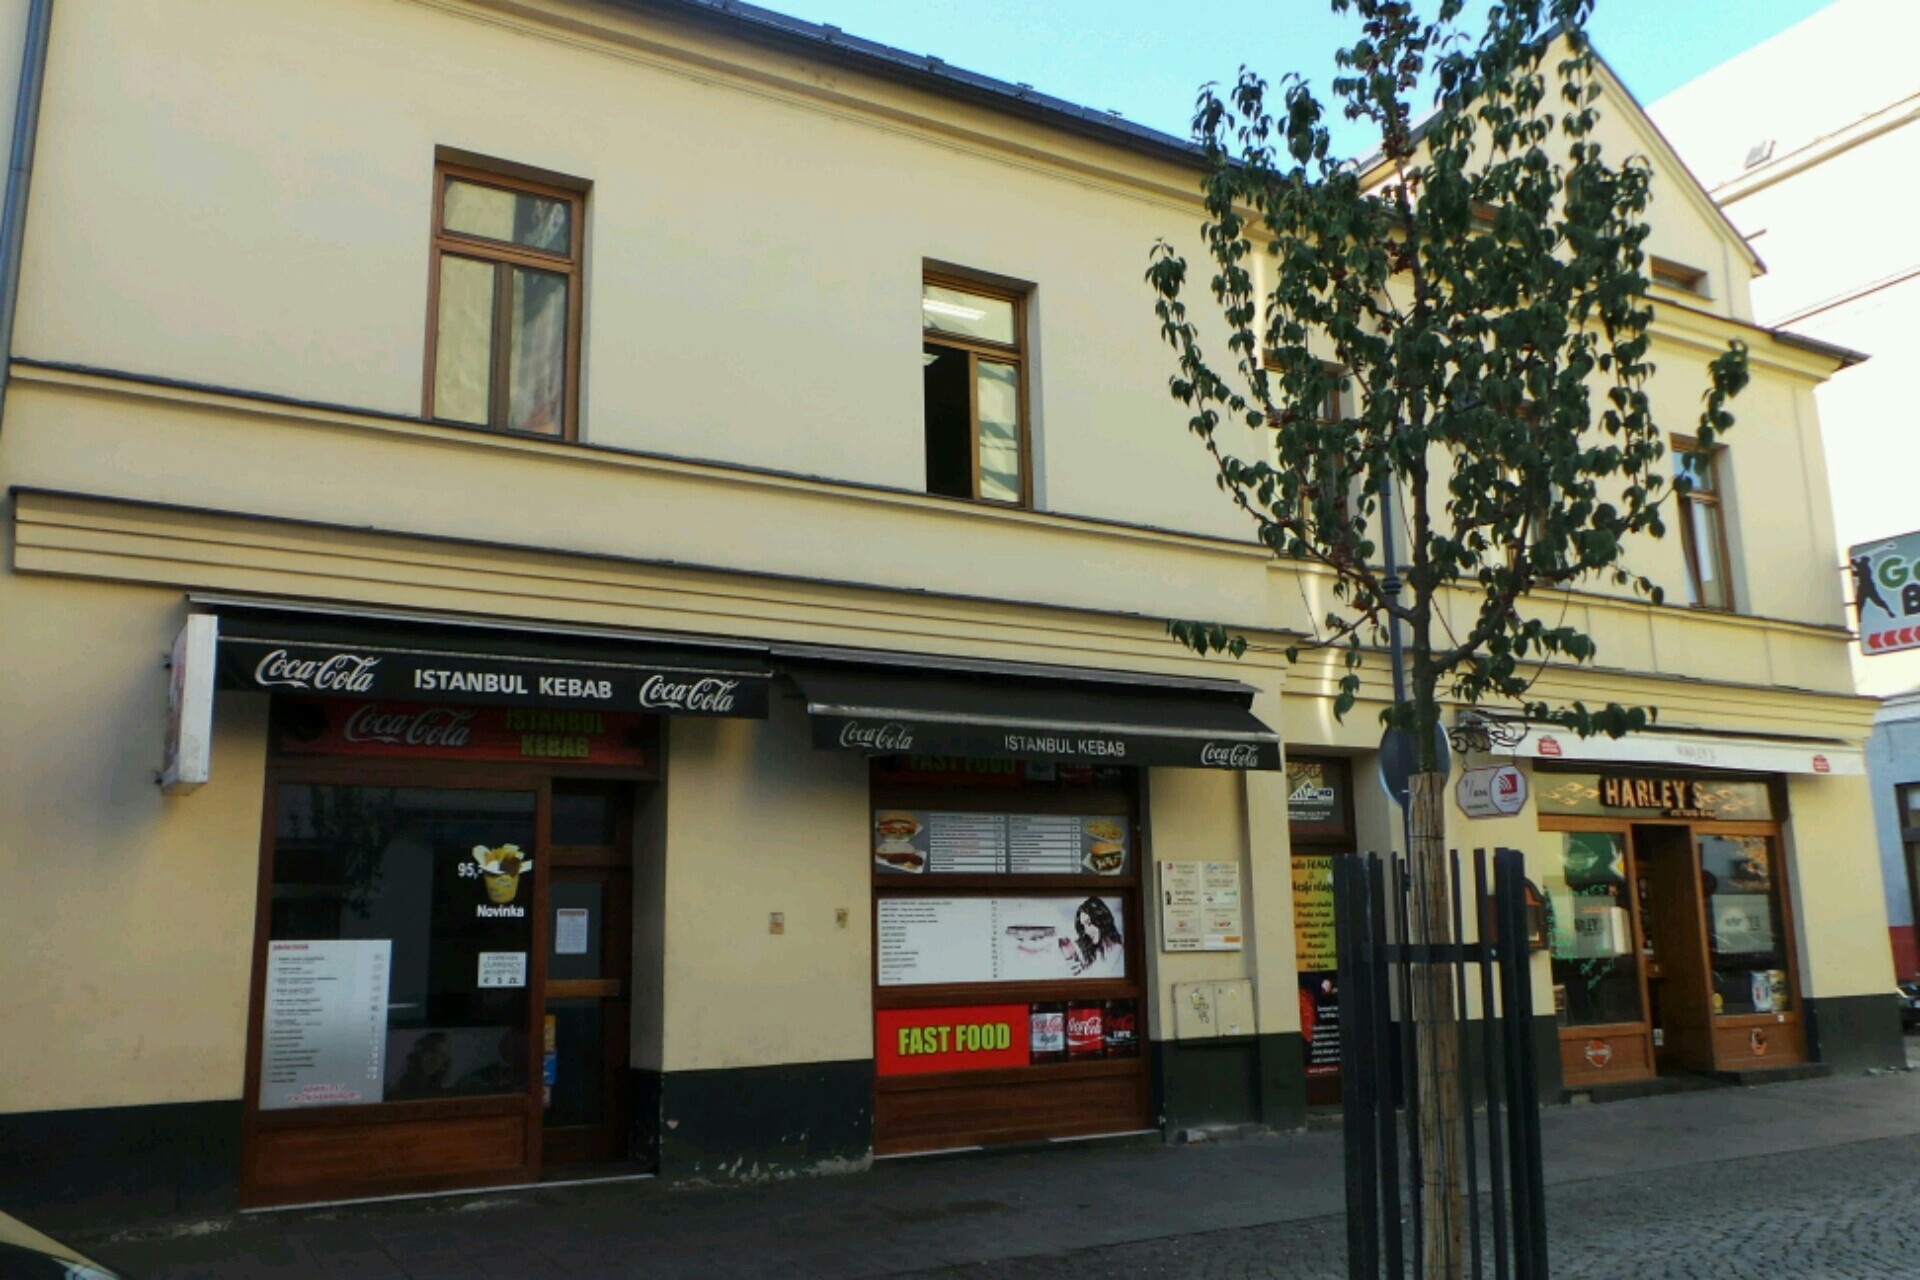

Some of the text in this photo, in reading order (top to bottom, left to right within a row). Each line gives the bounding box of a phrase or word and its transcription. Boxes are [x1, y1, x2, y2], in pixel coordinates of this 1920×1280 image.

[255, 649, 382, 692] Coca-Cola
[414, 669, 612, 699] ISTANBUL KEBAB
[639, 674, 739, 712] Coca-Cola
[344, 703, 476, 746] Coca-Cola
[506, 708, 605, 734] ISTANBUL
[839, 720, 914, 750] Coca-Cola
[520, 734, 590, 758] KEBAB
[1004, 734, 1126, 758] ISTANBUL KEBAB
[1200, 742, 1259, 767] Coca-Cola
[477, 903, 525, 918] Novinka
[898, 1022, 1011, 1055] FAST FOOD
